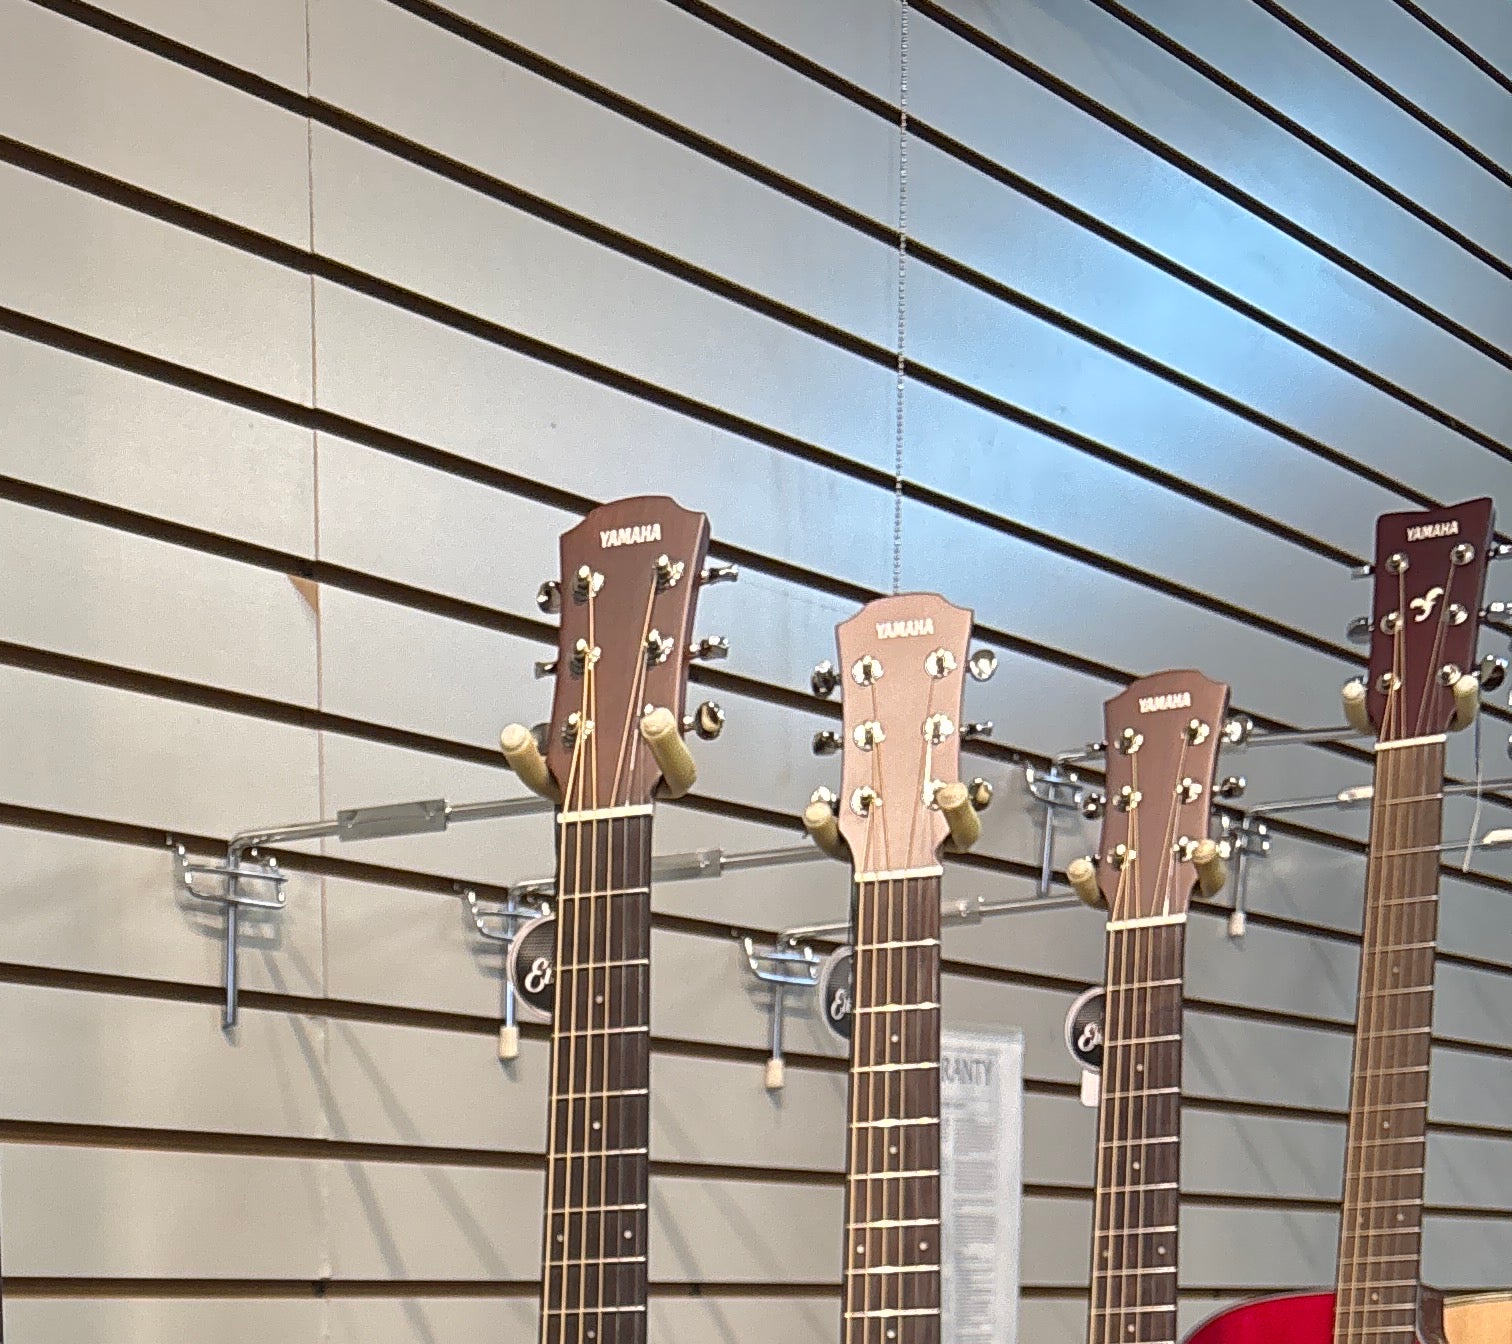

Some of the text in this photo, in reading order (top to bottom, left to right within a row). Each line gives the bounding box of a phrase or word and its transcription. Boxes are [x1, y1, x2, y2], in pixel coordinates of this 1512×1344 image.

[599, 523, 662, 549] YAMAHA
[1407, 520, 1459, 542] YAMAHA
[875, 617, 935, 640] YAMAHA
[1138, 691, 1191, 714] YAMAHA
